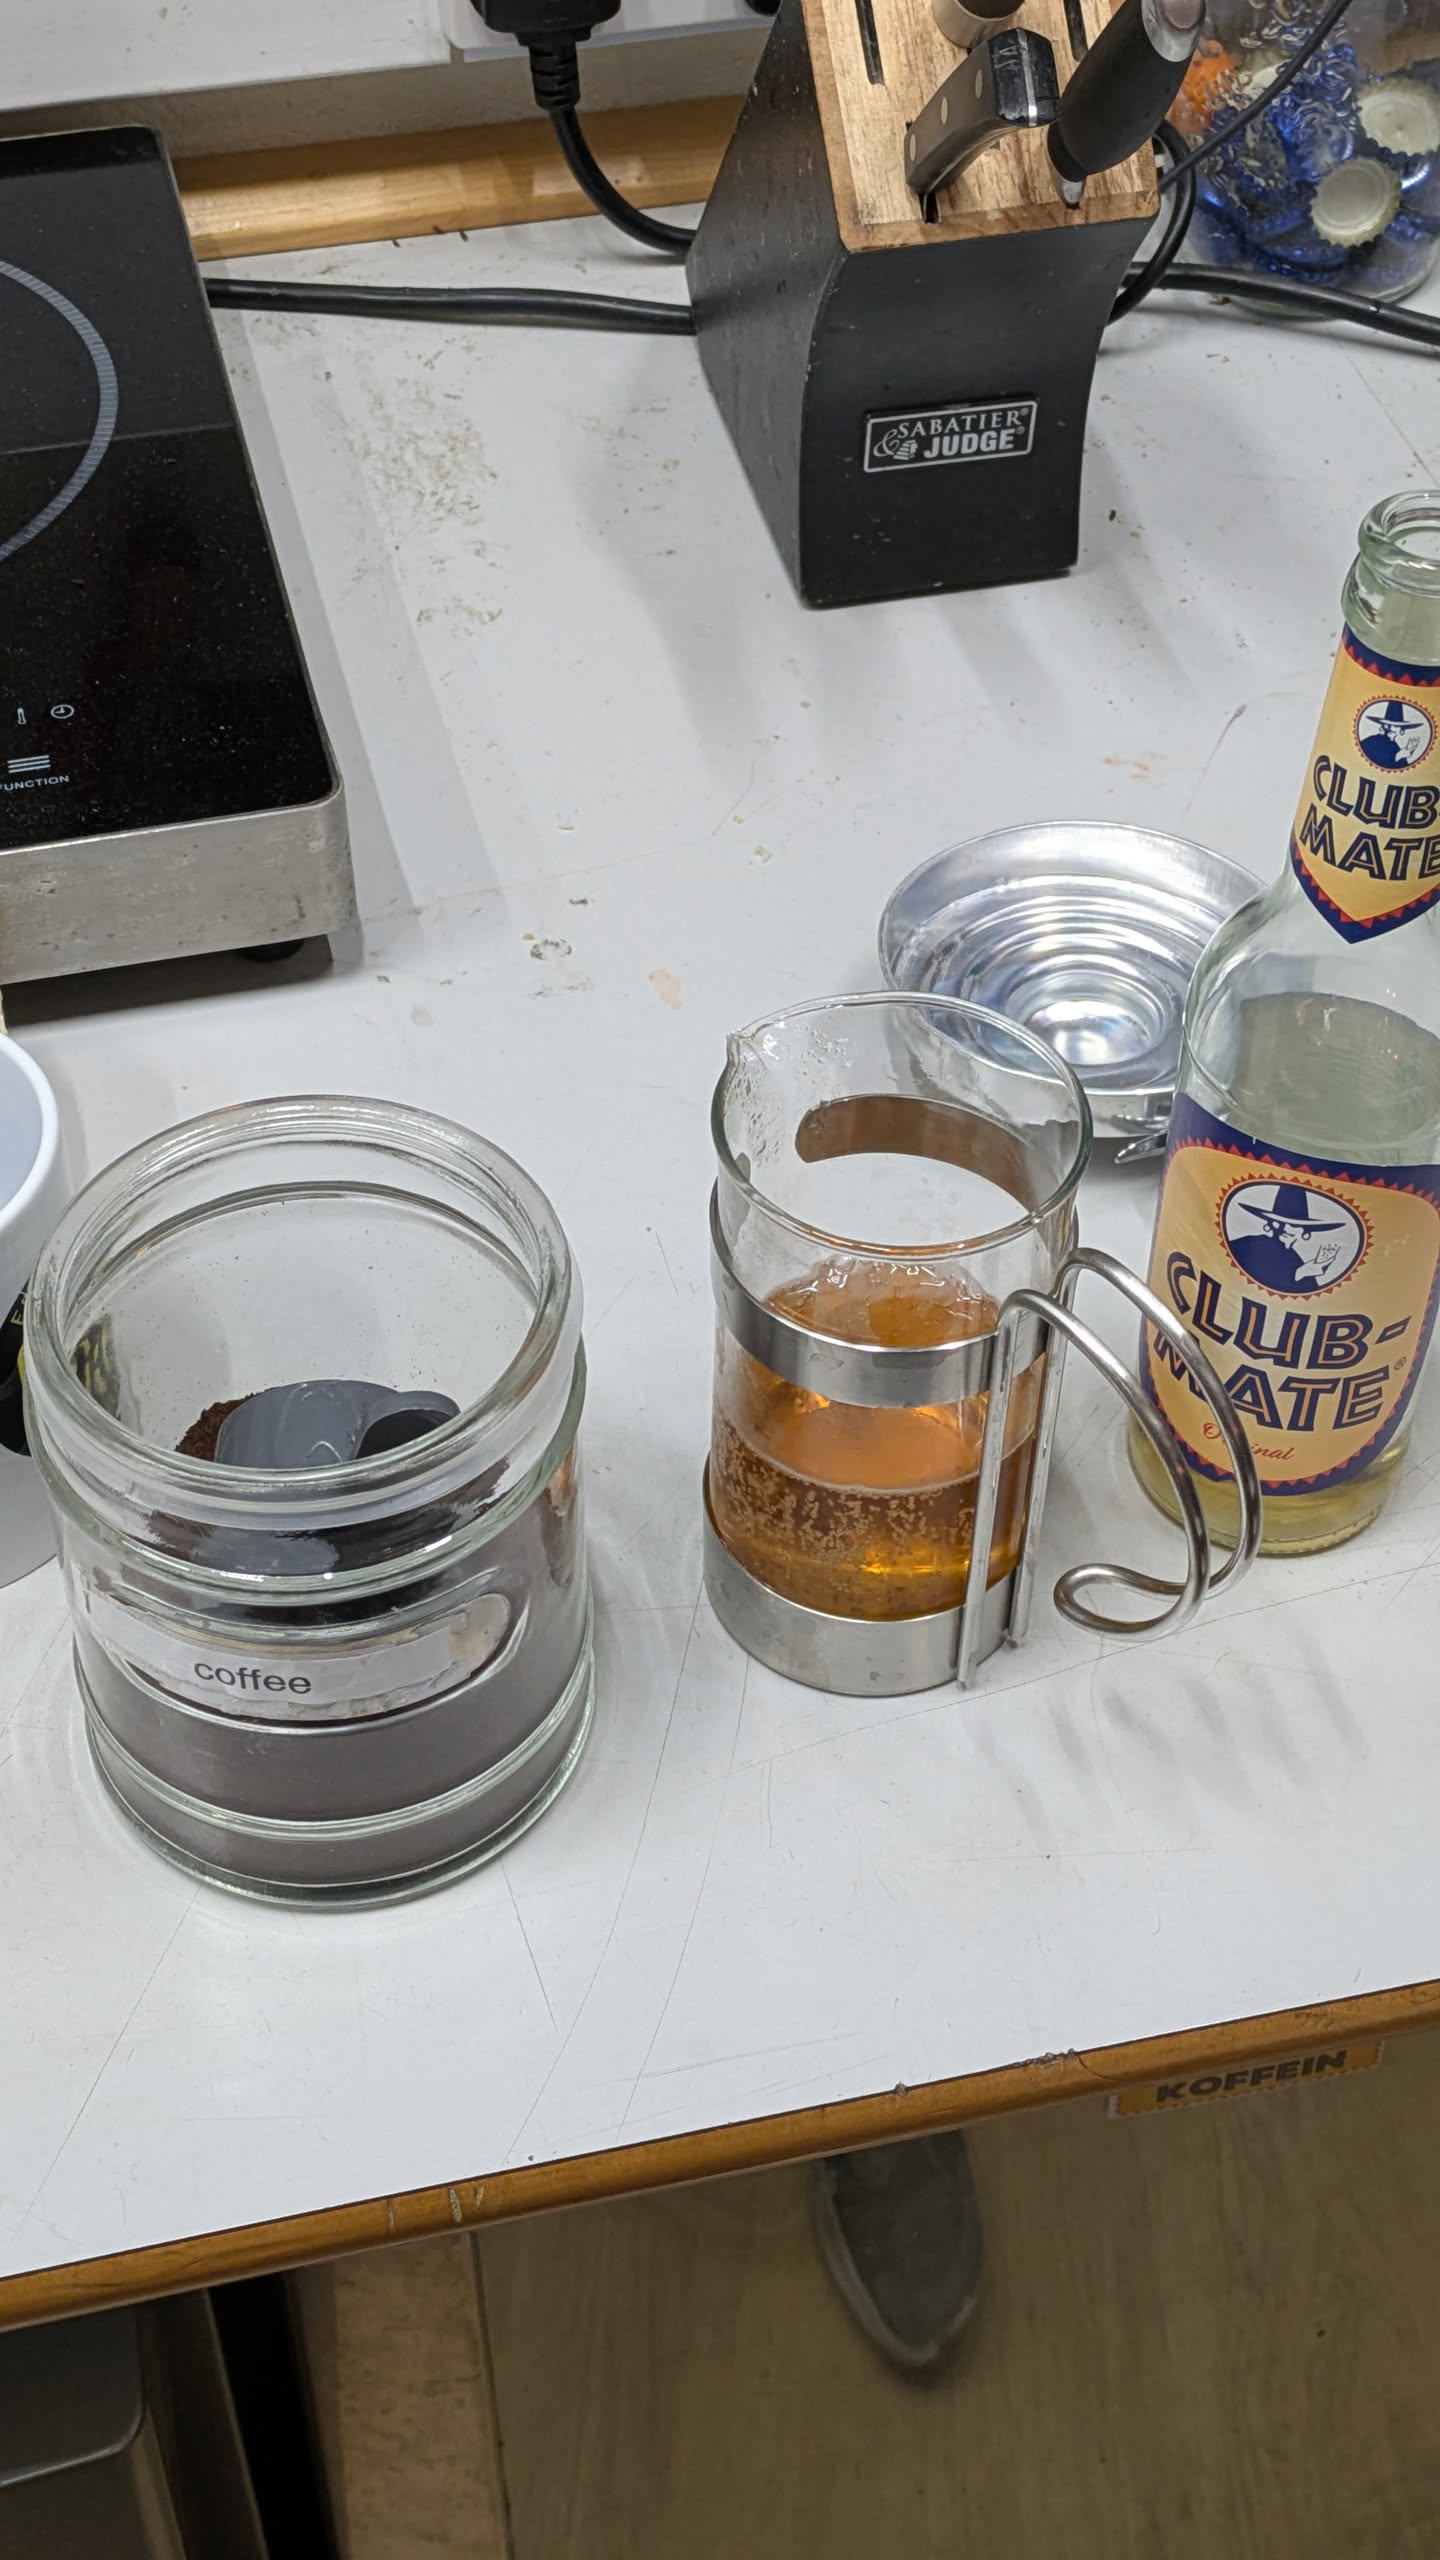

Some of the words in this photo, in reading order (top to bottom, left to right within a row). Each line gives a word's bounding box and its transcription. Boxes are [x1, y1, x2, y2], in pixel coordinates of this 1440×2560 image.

[0, 775, 70, 791] UNCTION
[1312, 755, 1440, 829] CLUB
[1203, 1422, 1295, 1460] Oinal
[194, 1663, 312, 1695] coffee
[1156, 2049, 1346, 2102] KOFFEIN
